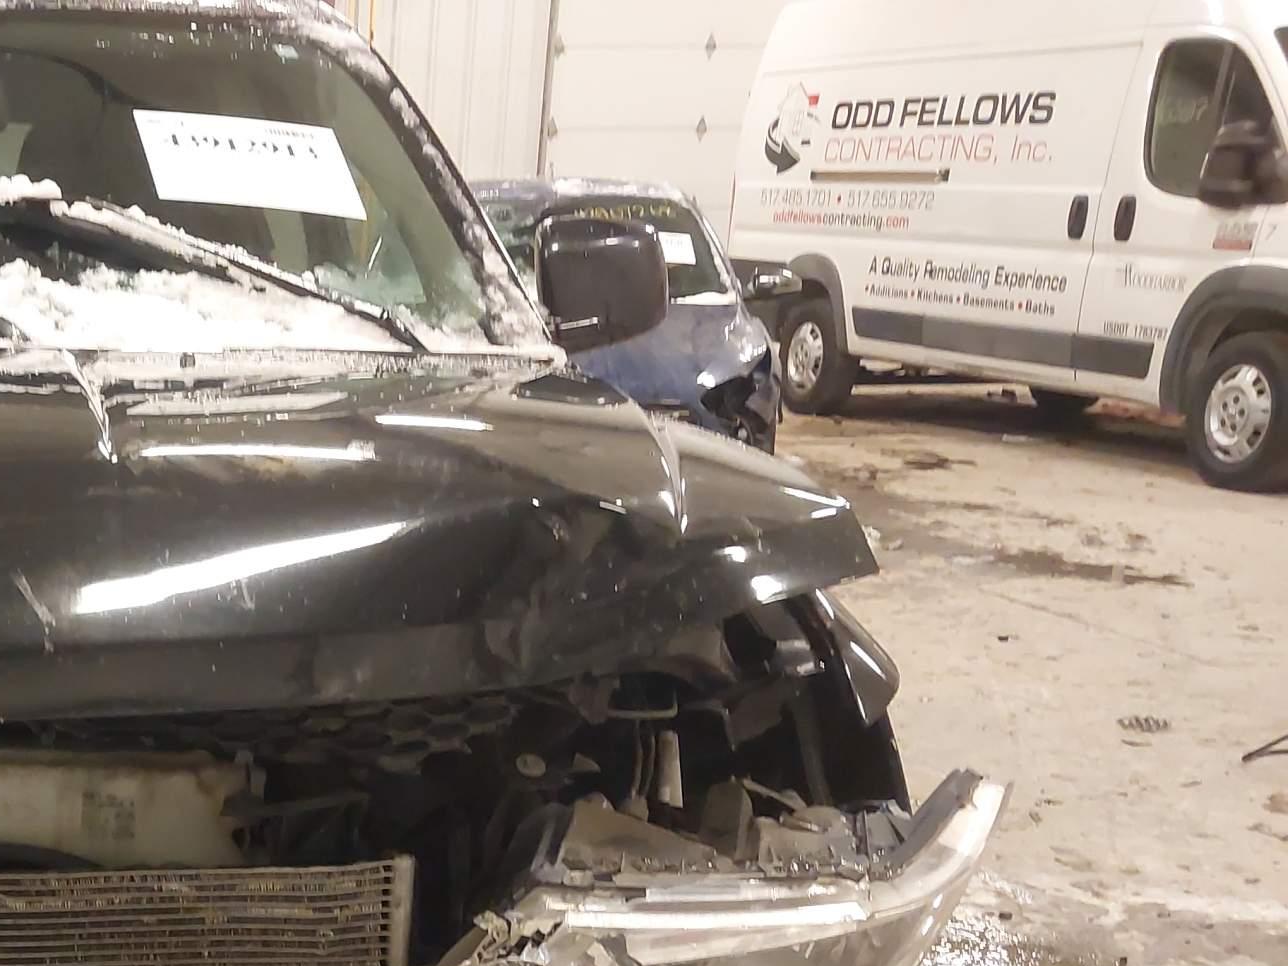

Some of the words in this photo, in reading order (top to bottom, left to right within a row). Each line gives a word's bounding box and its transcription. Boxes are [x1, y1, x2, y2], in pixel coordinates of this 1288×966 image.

[831, 99, 895, 129] ODD
[899, 91, 1057, 128] FELLOWS
[823, 133, 998, 164] CONTRACTING,
[1011, 135, 1054, 162] Inc.
[772, 209, 910, 231] oddfellowscontracting.com
[868, 255, 877, 275] A
[881, 256, 920, 281] Quality
[923, 259, 990, 289] Remodeling
[994, 266, 1068, 292] Experience
[917, 289, 954, 304] Kitchens
[963, 293, 1015, 311] Basements
[1025, 300, 1056, 316] Baths
